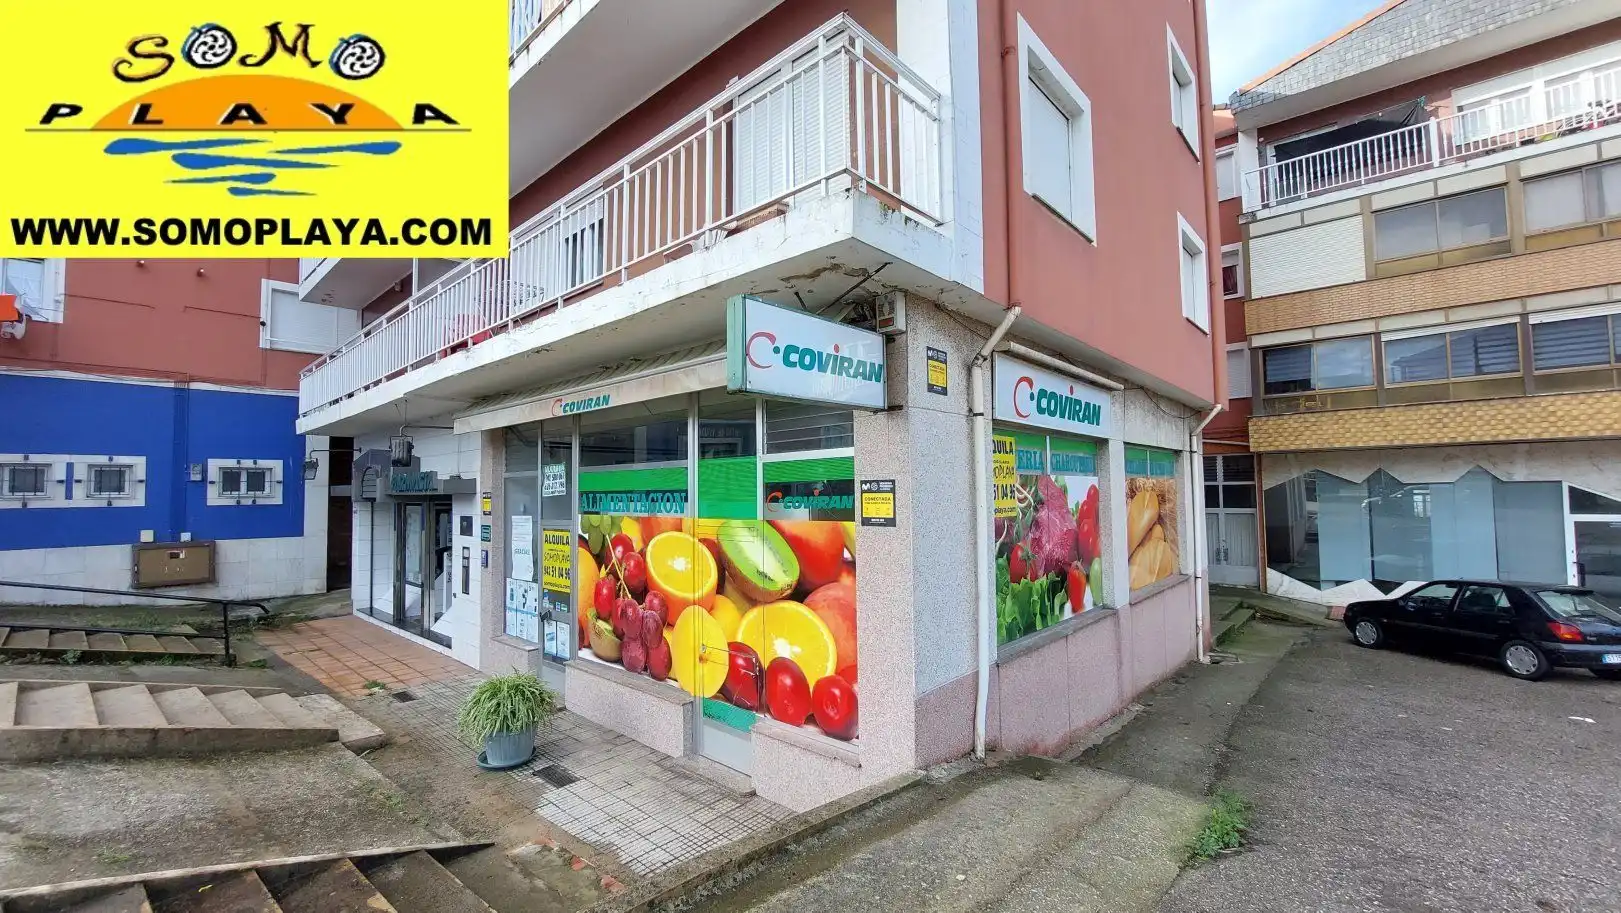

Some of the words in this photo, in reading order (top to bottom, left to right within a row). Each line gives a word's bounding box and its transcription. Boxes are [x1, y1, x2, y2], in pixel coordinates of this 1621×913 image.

[562, 394, 611, 414] COVIRAN
[581, 492, 687, 514] ALIMENTACION
[544, 533, 570, 546] ALQUILA
